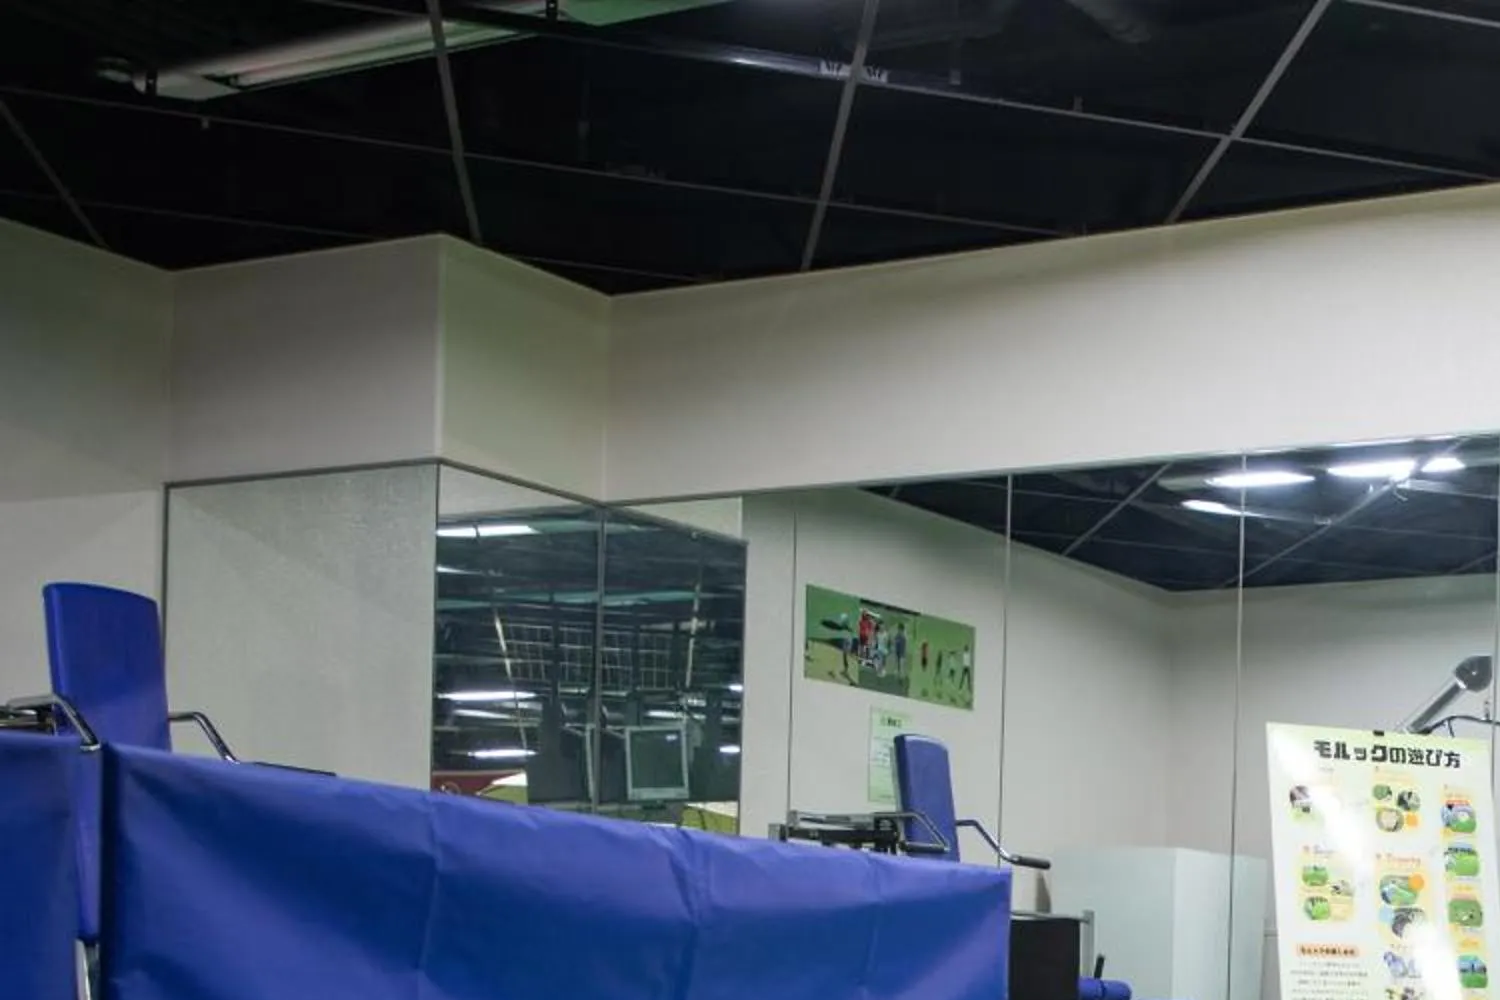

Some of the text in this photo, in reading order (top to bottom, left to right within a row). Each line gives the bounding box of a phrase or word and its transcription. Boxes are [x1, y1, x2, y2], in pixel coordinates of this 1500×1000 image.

[1314, 740, 1461, 769] モルックの遊び方
